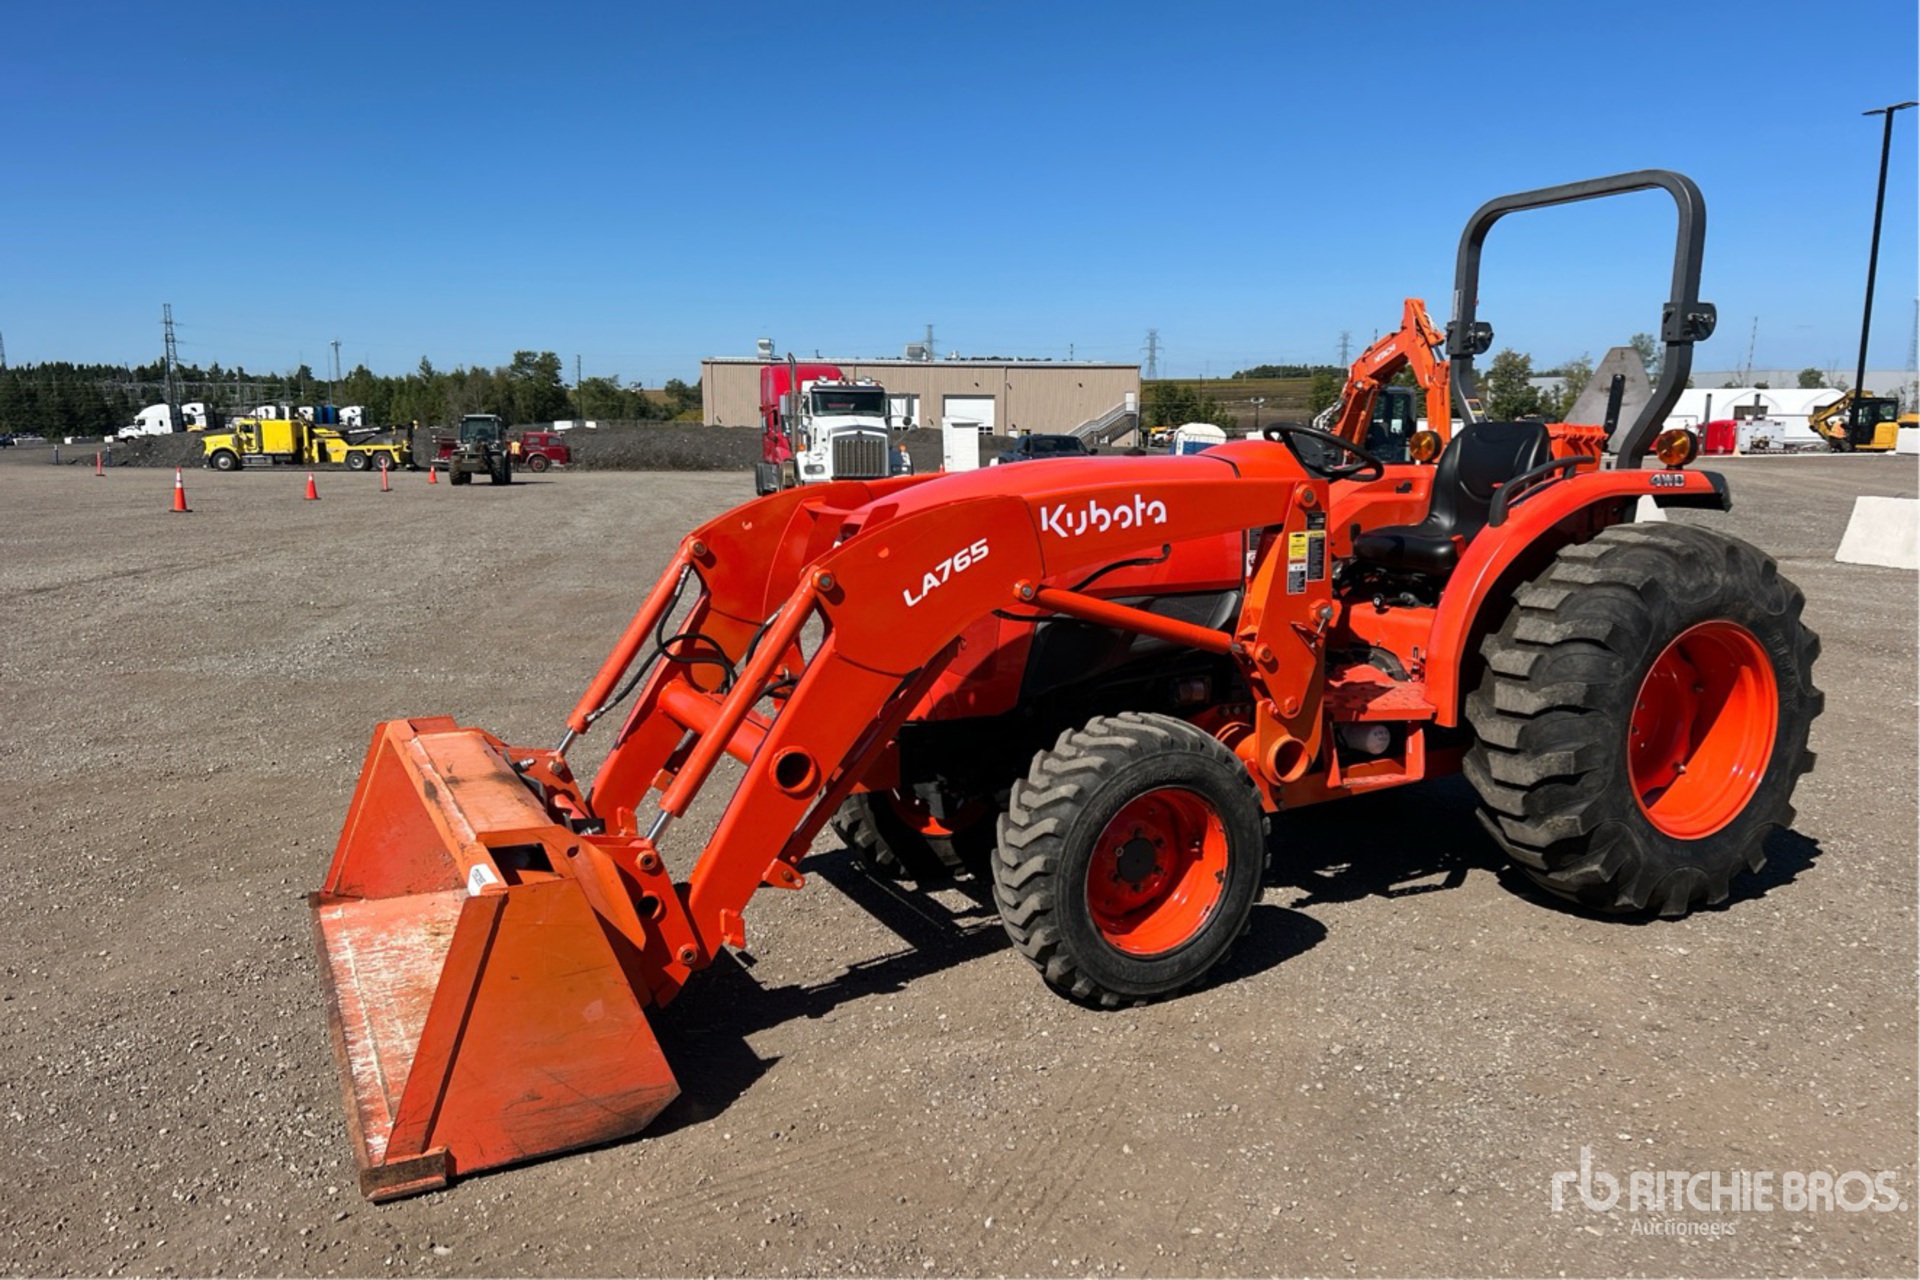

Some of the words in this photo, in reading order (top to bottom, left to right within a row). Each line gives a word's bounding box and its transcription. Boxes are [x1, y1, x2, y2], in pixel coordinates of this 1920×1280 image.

[1650, 473, 1685, 487] 4WD
[1040, 494, 1167, 537] Kubota
[903, 538, 990, 607] LA765
